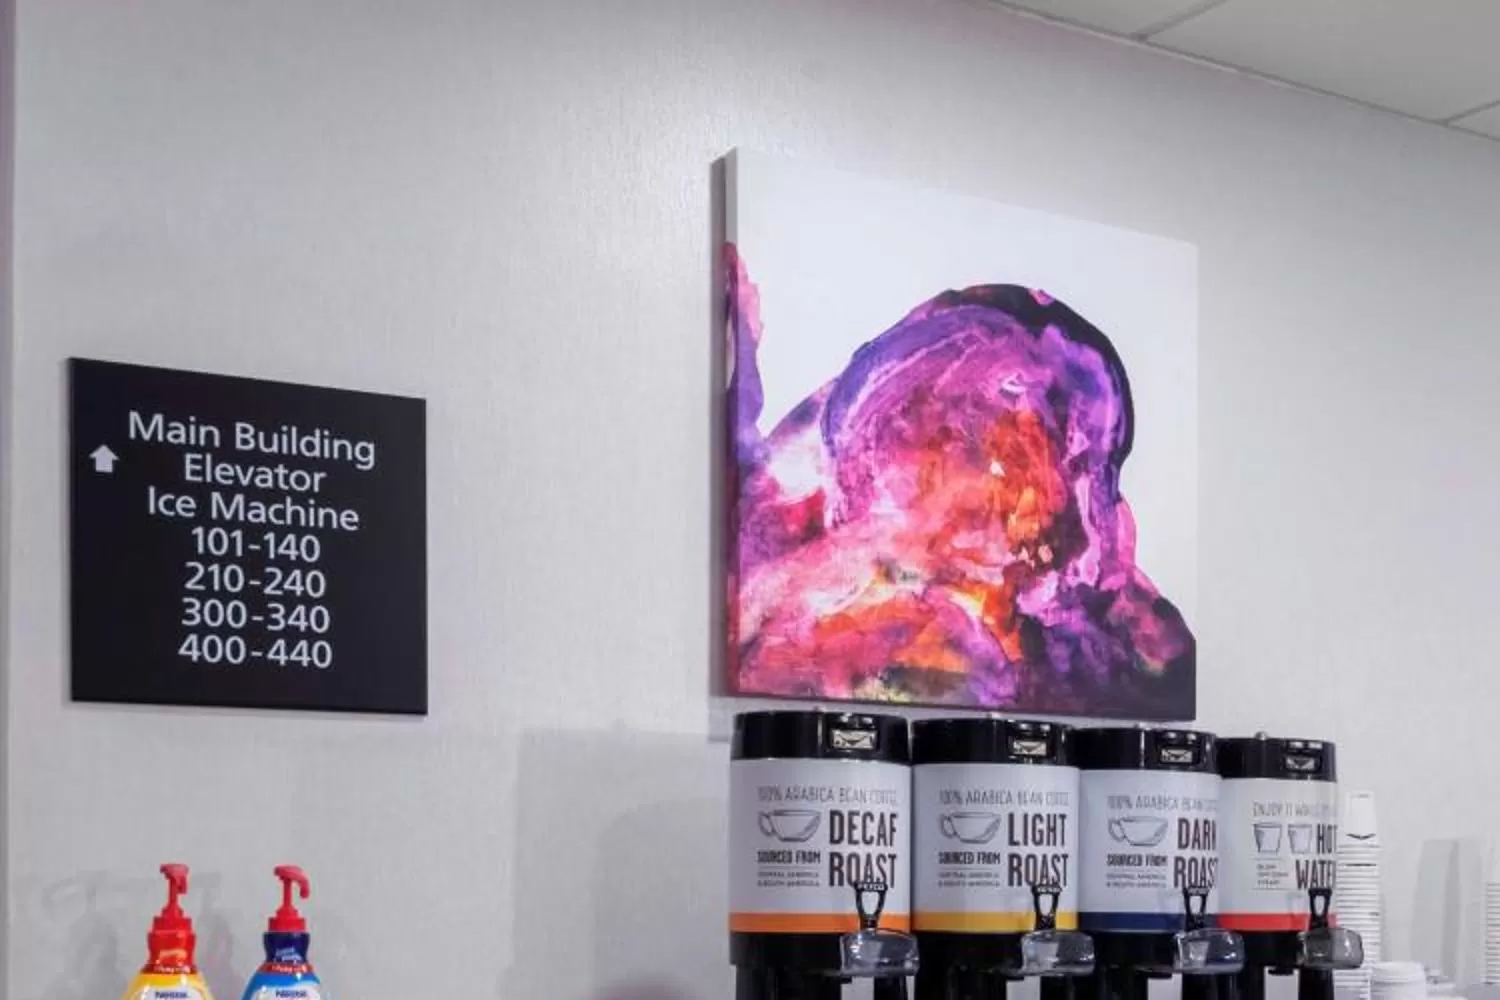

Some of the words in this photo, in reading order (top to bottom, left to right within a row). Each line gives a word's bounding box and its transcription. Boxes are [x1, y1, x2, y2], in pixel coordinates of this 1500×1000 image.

[129, 410, 221, 448] Main
[235, 422, 375, 470] Building
[184, 453, 327, 493] Elevator
[148, 486, 197, 517] Ice
[211, 491, 360, 531] Machine
[191, 526, 321, 562] 101-140
[184, 561, 327, 598] 210-240
[181, 597, 331, 633] 300-340
[178, 633, 333, 668] 400-440
[785, 786, 834, 802] ARABICA
[965, 789, 1013, 806] ARABICA
[1136, 795, 1178, 811] ARABICA
[829, 809, 898, 847] DECAF
[1007, 812, 1067, 847] LIGHT
[757, 850, 793, 863] SOURCED
[796, 850, 821, 863] FROM
[829, 851, 897, 888] ROAST
[938, 852, 975, 864] SOURCED
[977, 852, 1001, 864] FROM
[1007, 853, 1069, 888] ROAST
[1145, 854, 1168, 866] FROM
